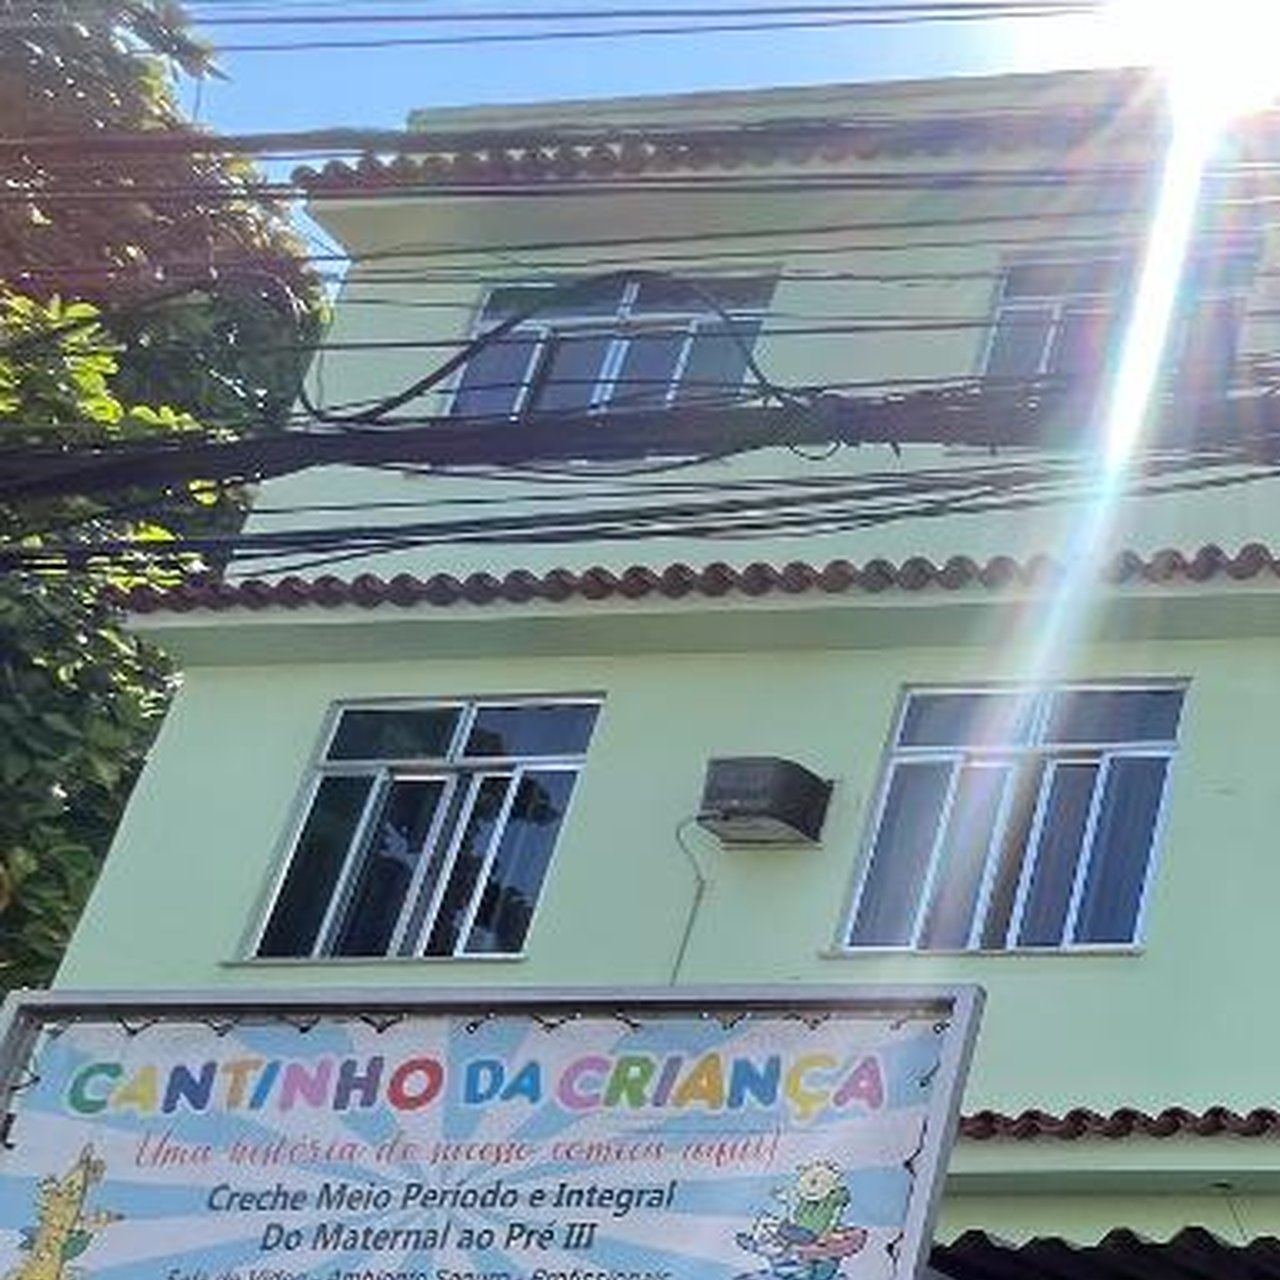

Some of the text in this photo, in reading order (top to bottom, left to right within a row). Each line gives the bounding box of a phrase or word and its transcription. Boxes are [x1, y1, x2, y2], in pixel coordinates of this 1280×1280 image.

[66, 1052, 885, 1120] CANTINHO DA CRIANÇA
[134, 1128, 212, 1168] Uma
[207, 1177, 677, 1217] Creche Meio Período e Integral
[260, 1219, 599, 1250] Do Maternal ao Pré III
